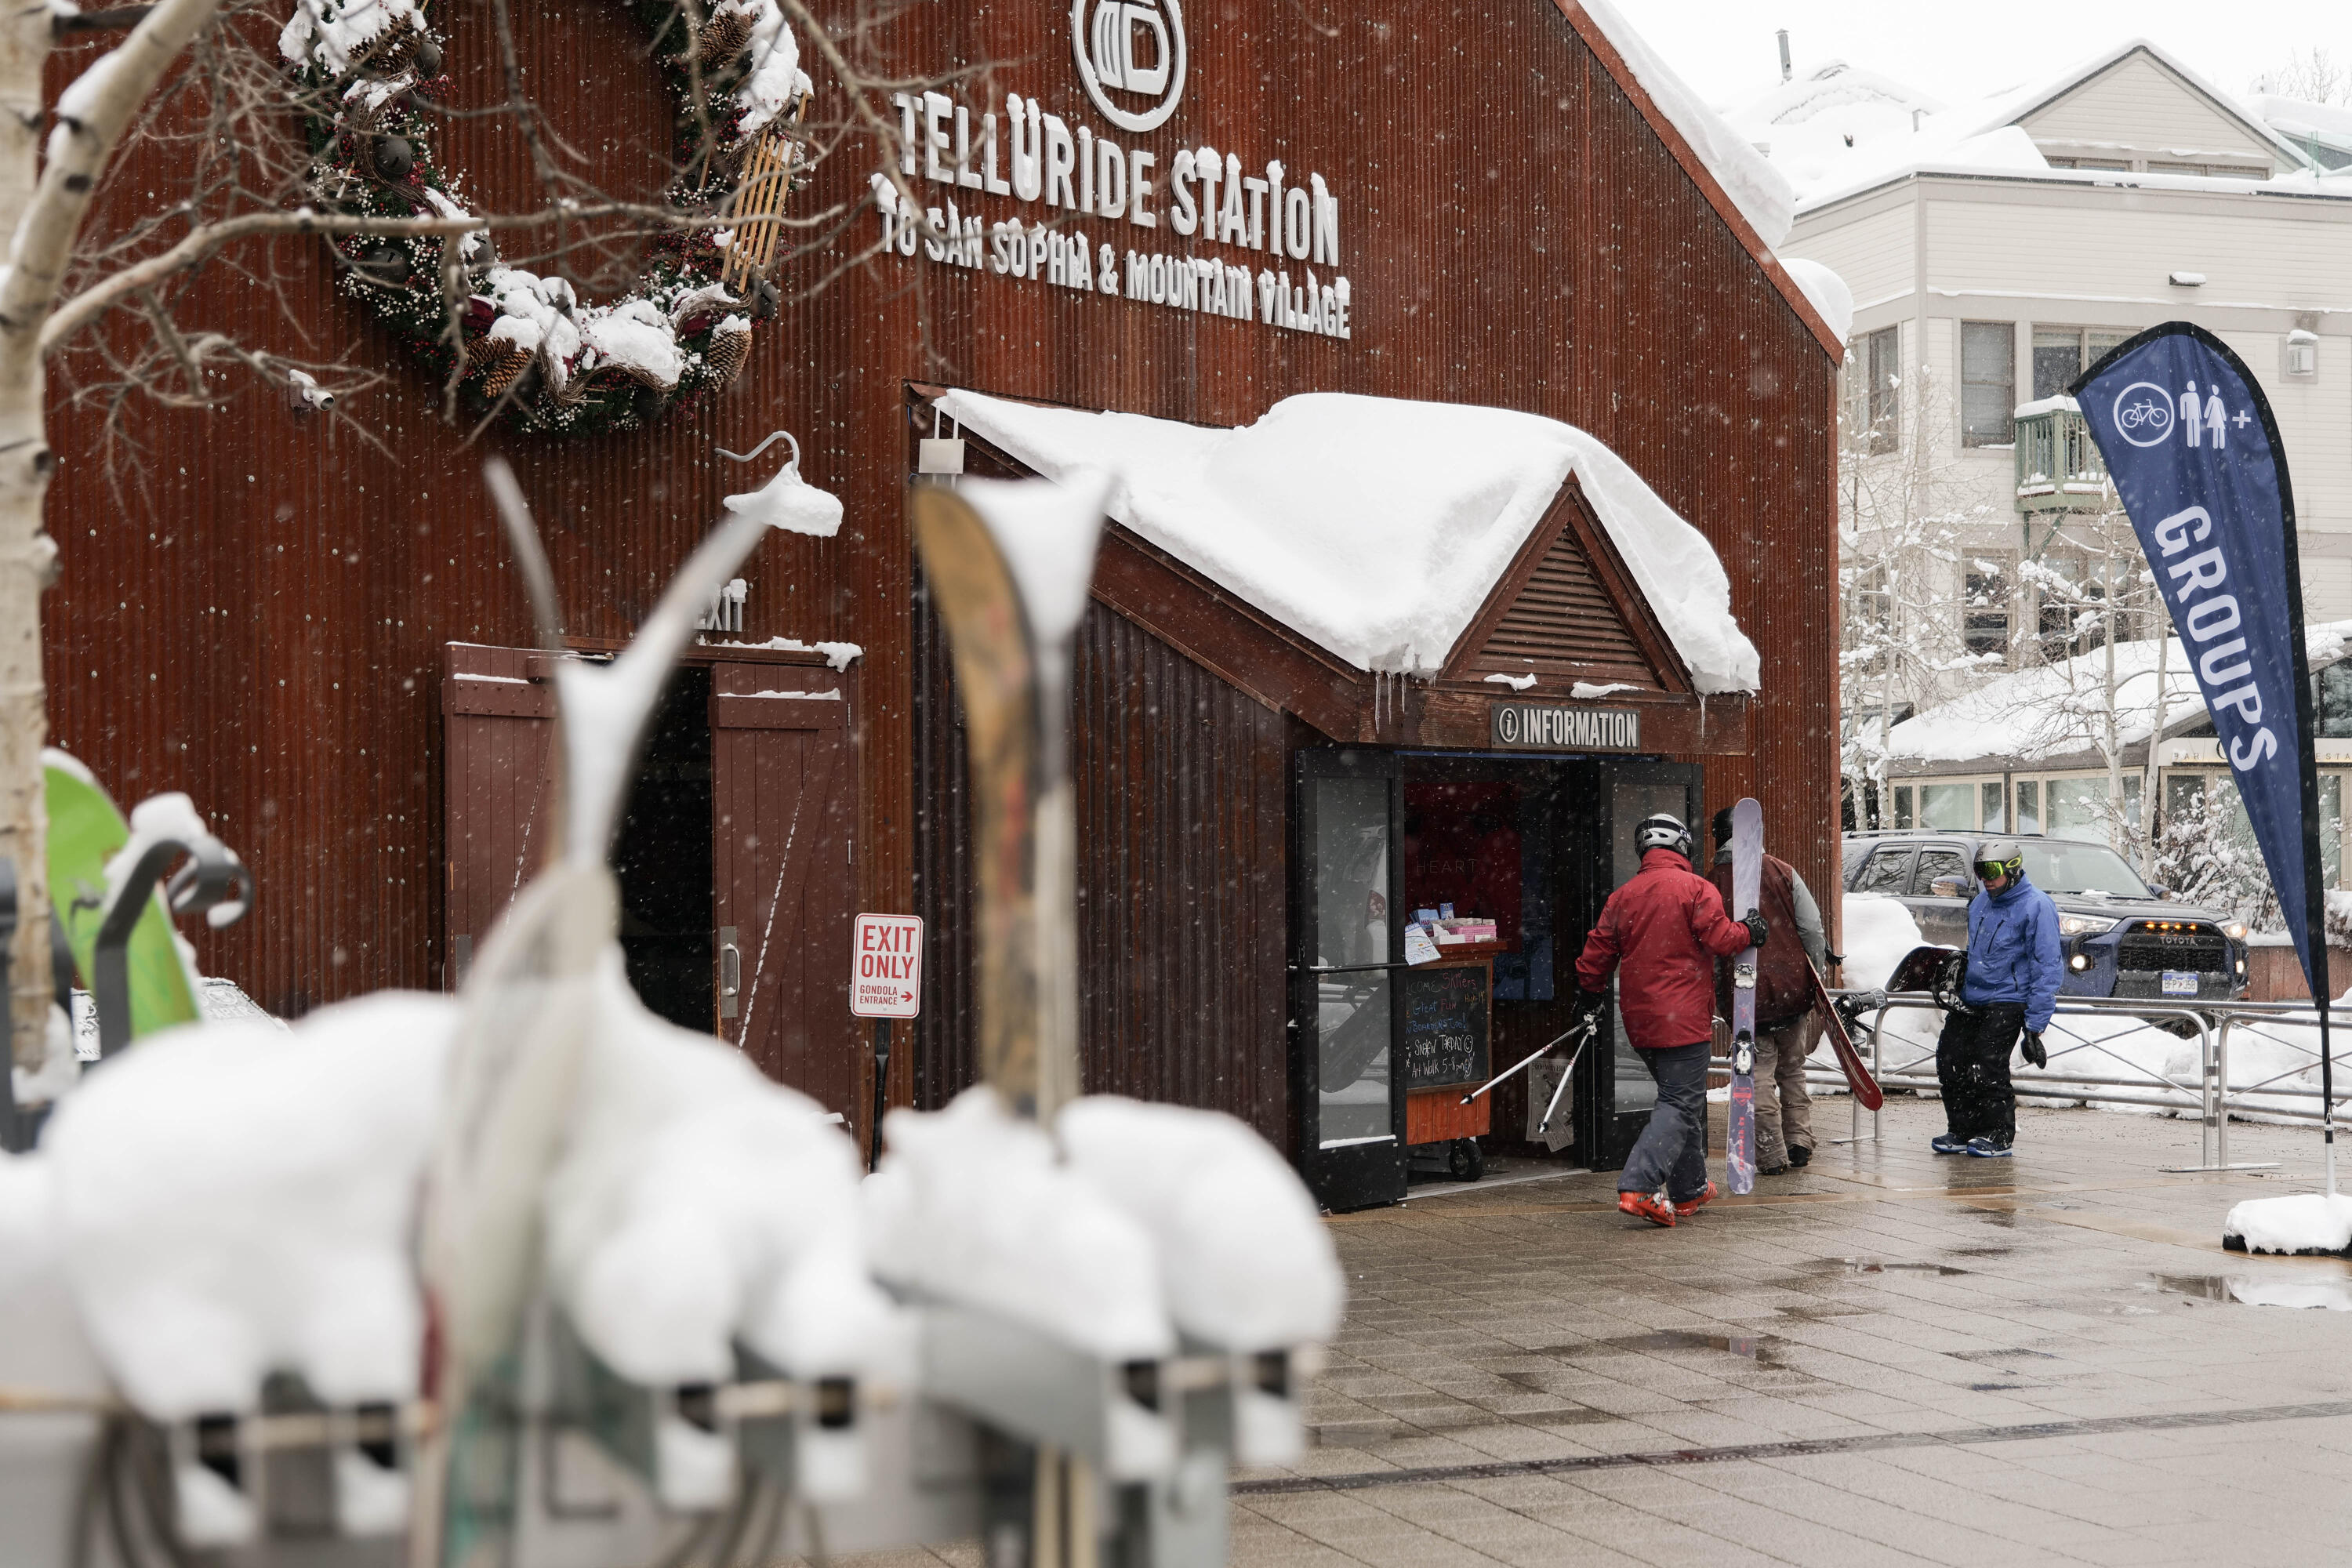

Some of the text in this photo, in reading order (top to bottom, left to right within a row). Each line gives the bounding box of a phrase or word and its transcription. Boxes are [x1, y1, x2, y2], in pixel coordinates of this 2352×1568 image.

[893, 93, 1338, 267] TELLURIDE STATION
[876, 191, 1351, 339] TO SAN SOPHIA & MOUNTAIN VILLAGE
[2154, 505, 2278, 772] GROUPS
[1523, 708, 1637, 747] INFORMATION
[1417, 858, 1478, 873] HEART
[862, 925, 916, 953] EXIT
[2160, 936, 2197, 946] TOYOTA
[861, 954, 915, 979] ONLY
[859, 985, 898, 996] GONDOLA
[859, 996, 898, 1005] ENTRANCE
